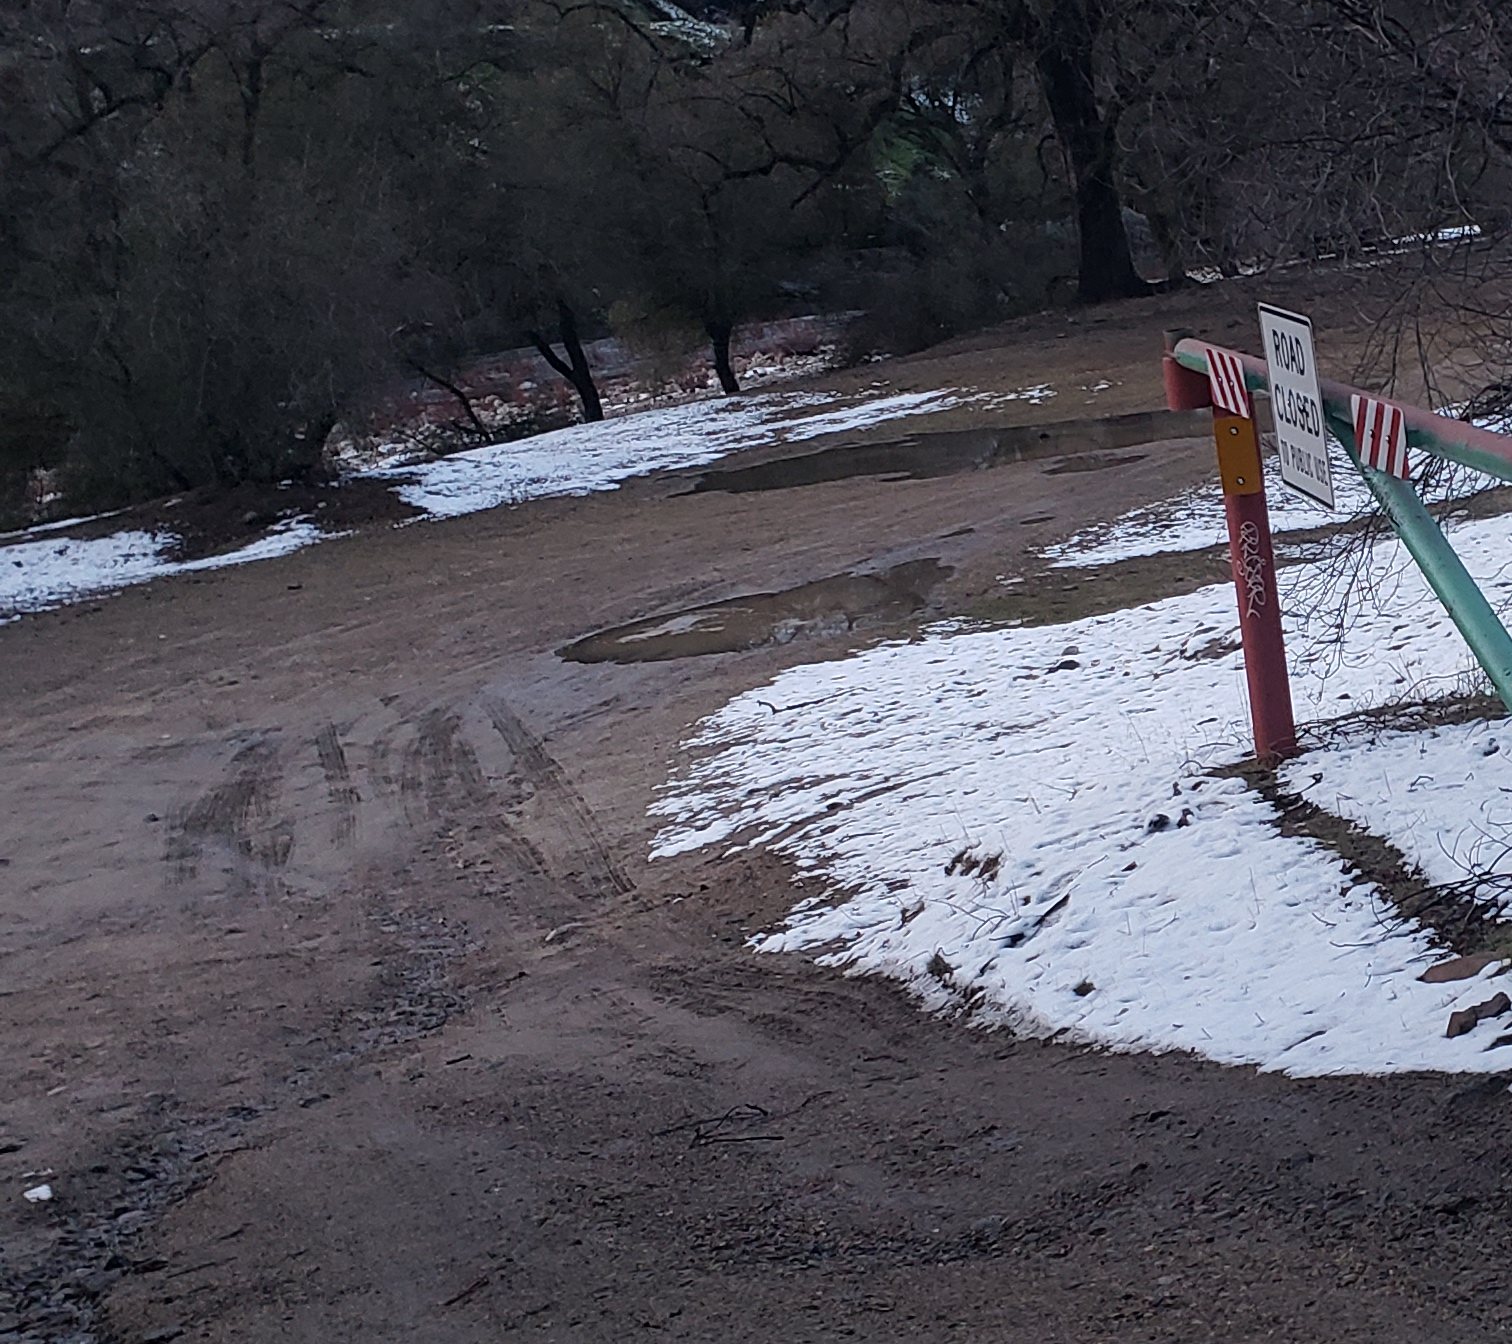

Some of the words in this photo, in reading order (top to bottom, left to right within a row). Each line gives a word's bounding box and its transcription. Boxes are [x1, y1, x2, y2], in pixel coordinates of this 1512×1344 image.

[1272, 329, 1305, 375] ROAD
[1274, 384, 1319, 437] CLOSED
[1280, 439, 1290, 466] TO
[1290, 444, 1314, 480] PUBLIC
[1314, 456, 1329, 486] USE
